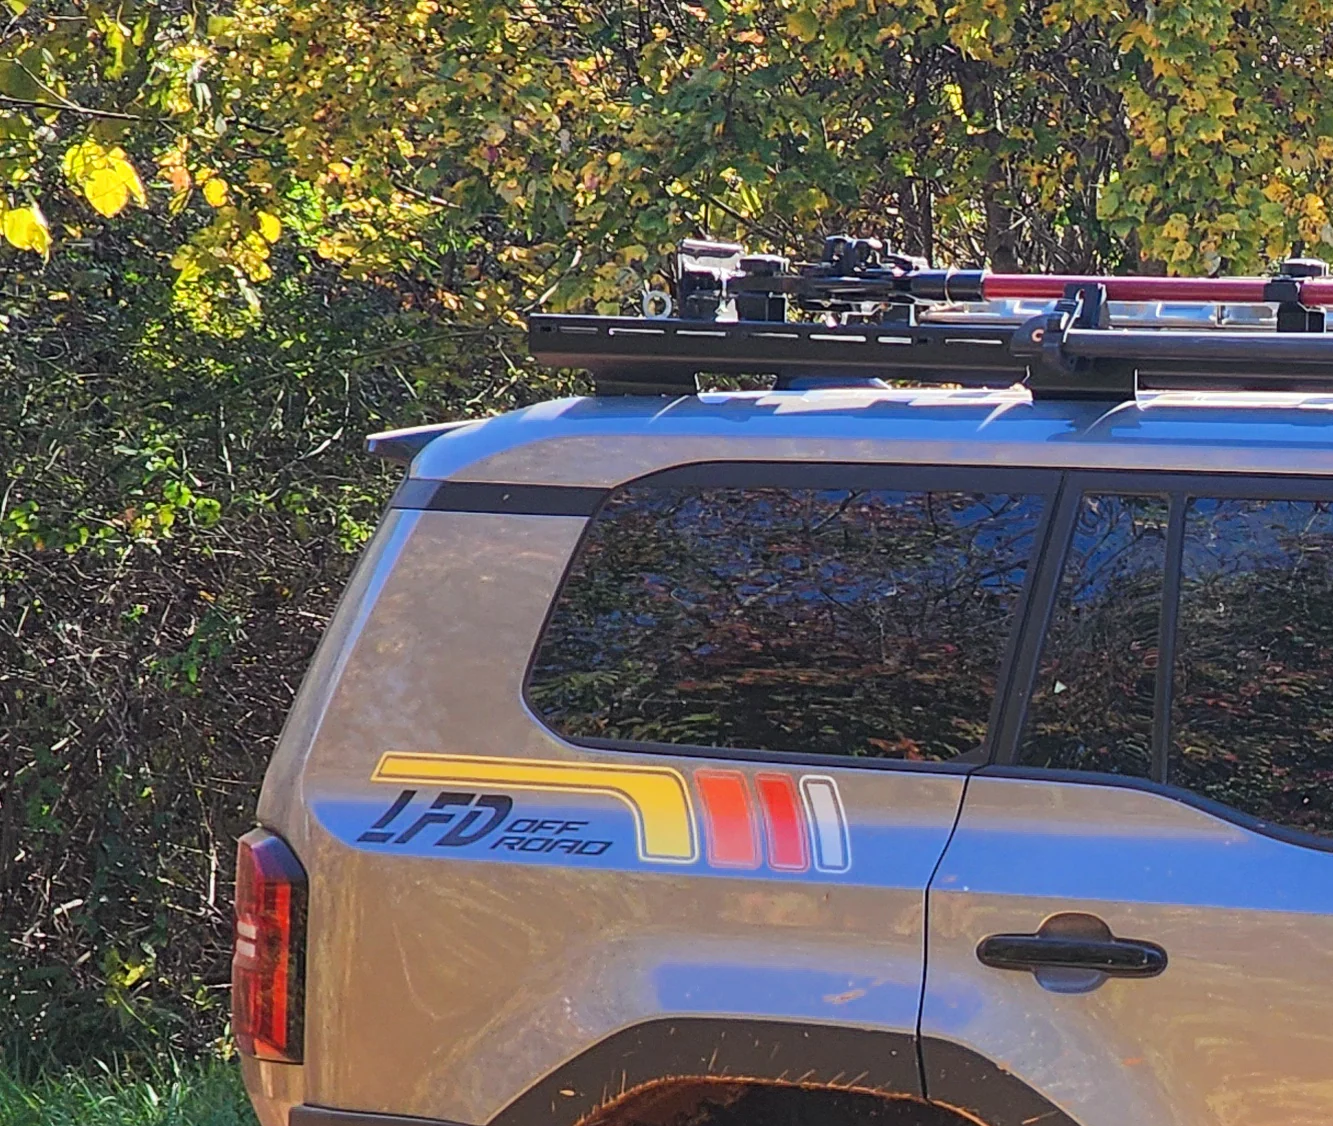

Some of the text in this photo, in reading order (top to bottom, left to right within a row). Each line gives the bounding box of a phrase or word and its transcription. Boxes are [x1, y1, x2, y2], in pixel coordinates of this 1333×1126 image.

[357, 790, 514, 847] LFD
[503, 818, 589, 835] OFF
[491, 836, 613, 855] ROAD
